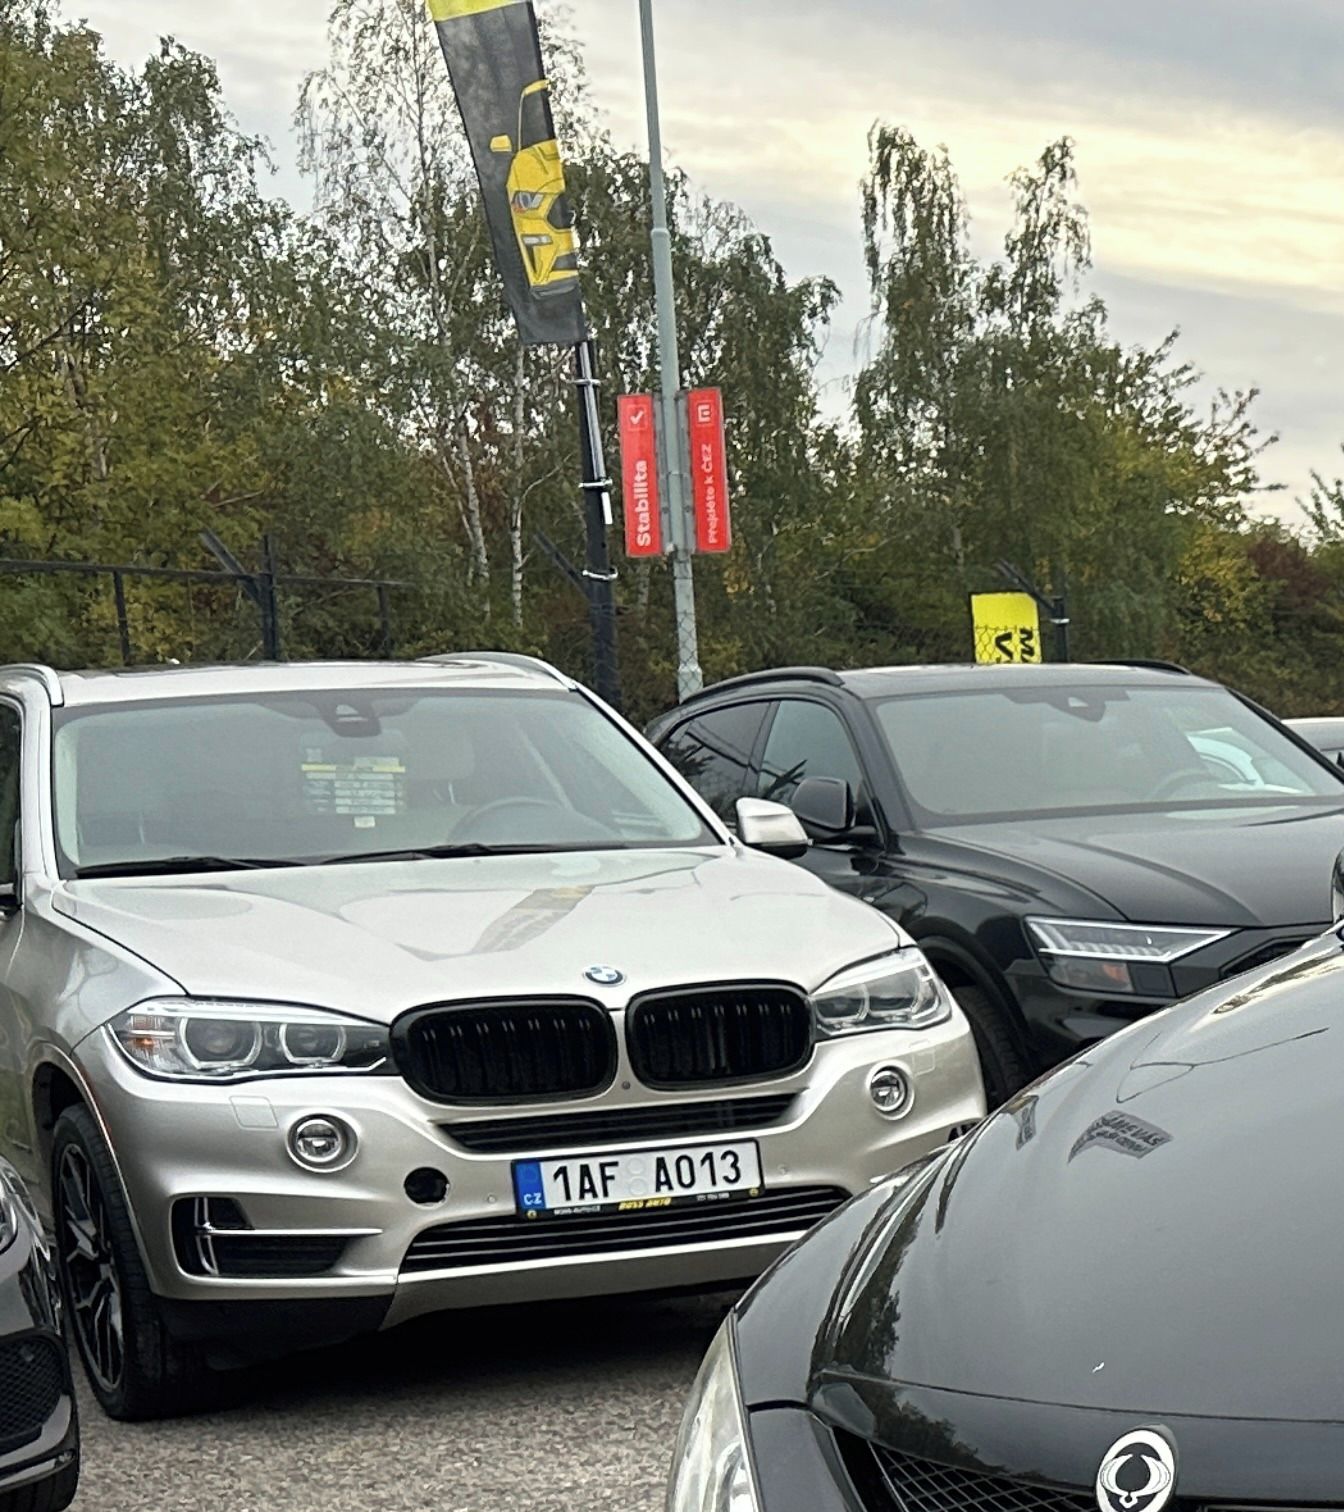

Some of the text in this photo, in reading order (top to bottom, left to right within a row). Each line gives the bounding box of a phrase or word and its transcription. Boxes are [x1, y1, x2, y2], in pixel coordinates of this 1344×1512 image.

[553, 1149, 741, 1201] 1AF A013
[523, 1192, 542, 1206] CZ
